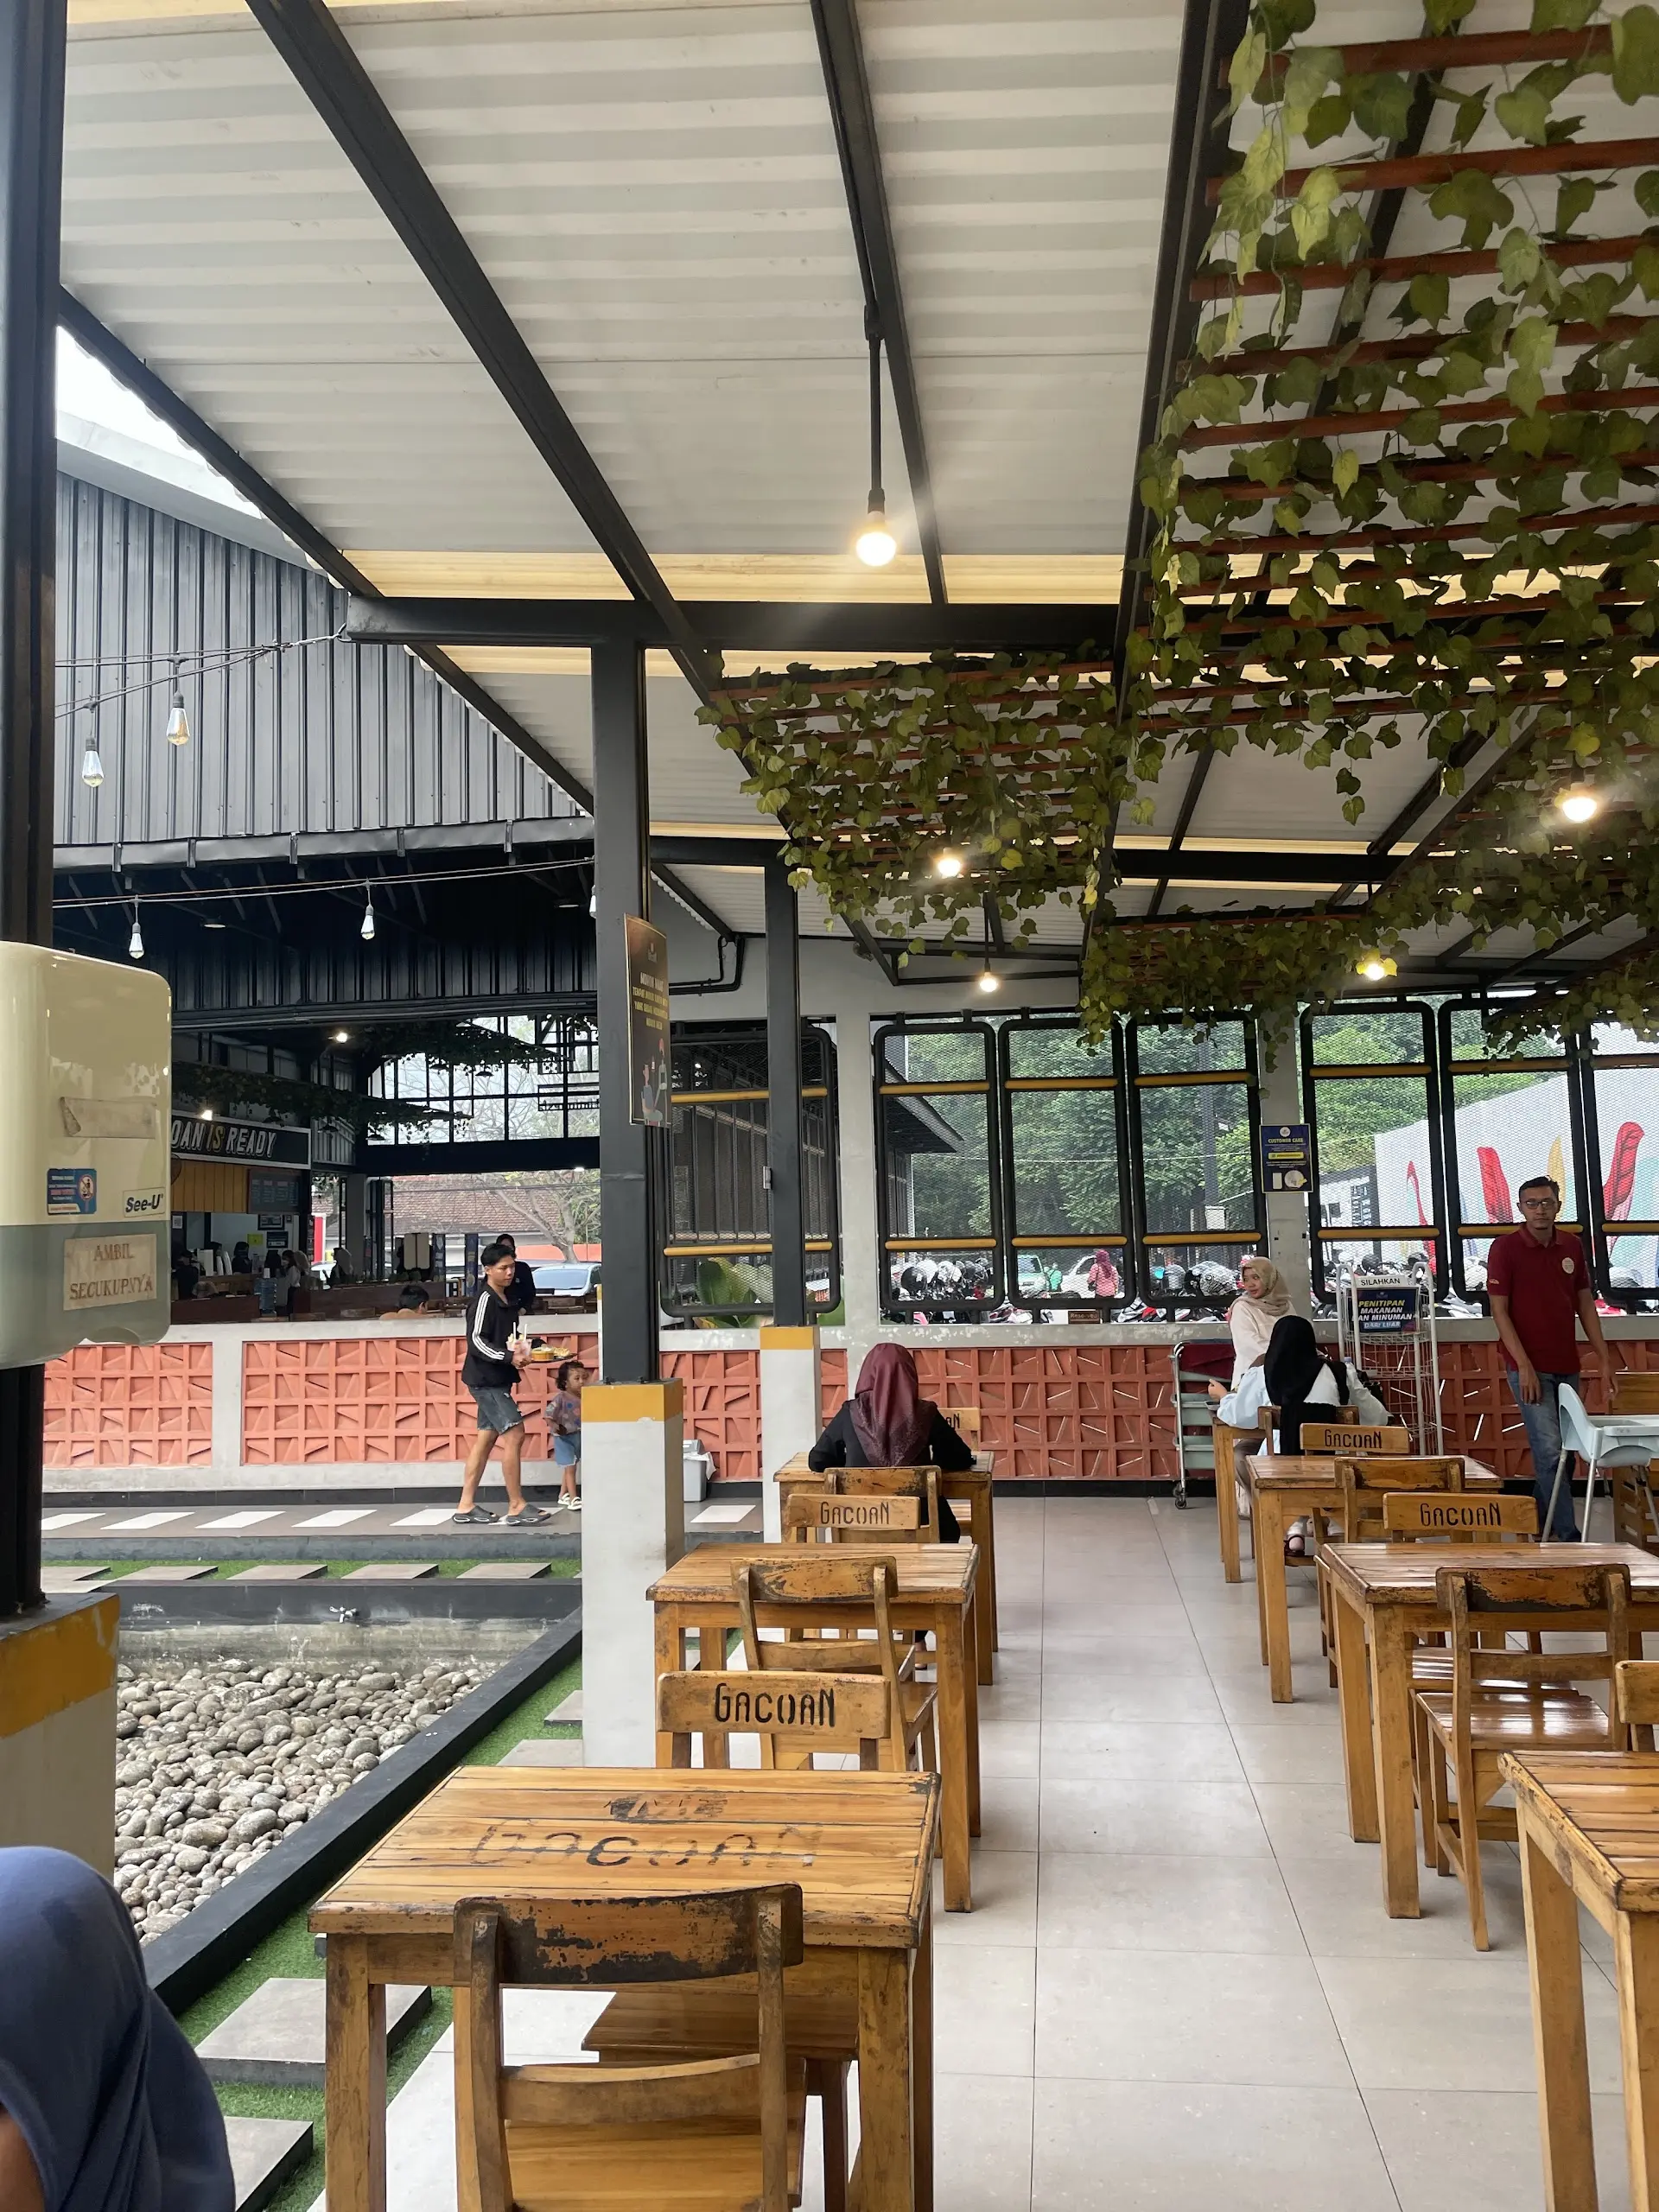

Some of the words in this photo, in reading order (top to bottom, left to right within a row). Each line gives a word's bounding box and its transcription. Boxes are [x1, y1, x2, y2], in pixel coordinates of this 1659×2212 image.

[207, 1124, 226, 1152] IS
[226, 1127, 276, 1158] READY
[92, 1243, 135, 1262] AMBIL
[68, 1274, 154, 1300] SECUKUPNYA
[1360, 1278, 1401, 1287] SILAHKAN
